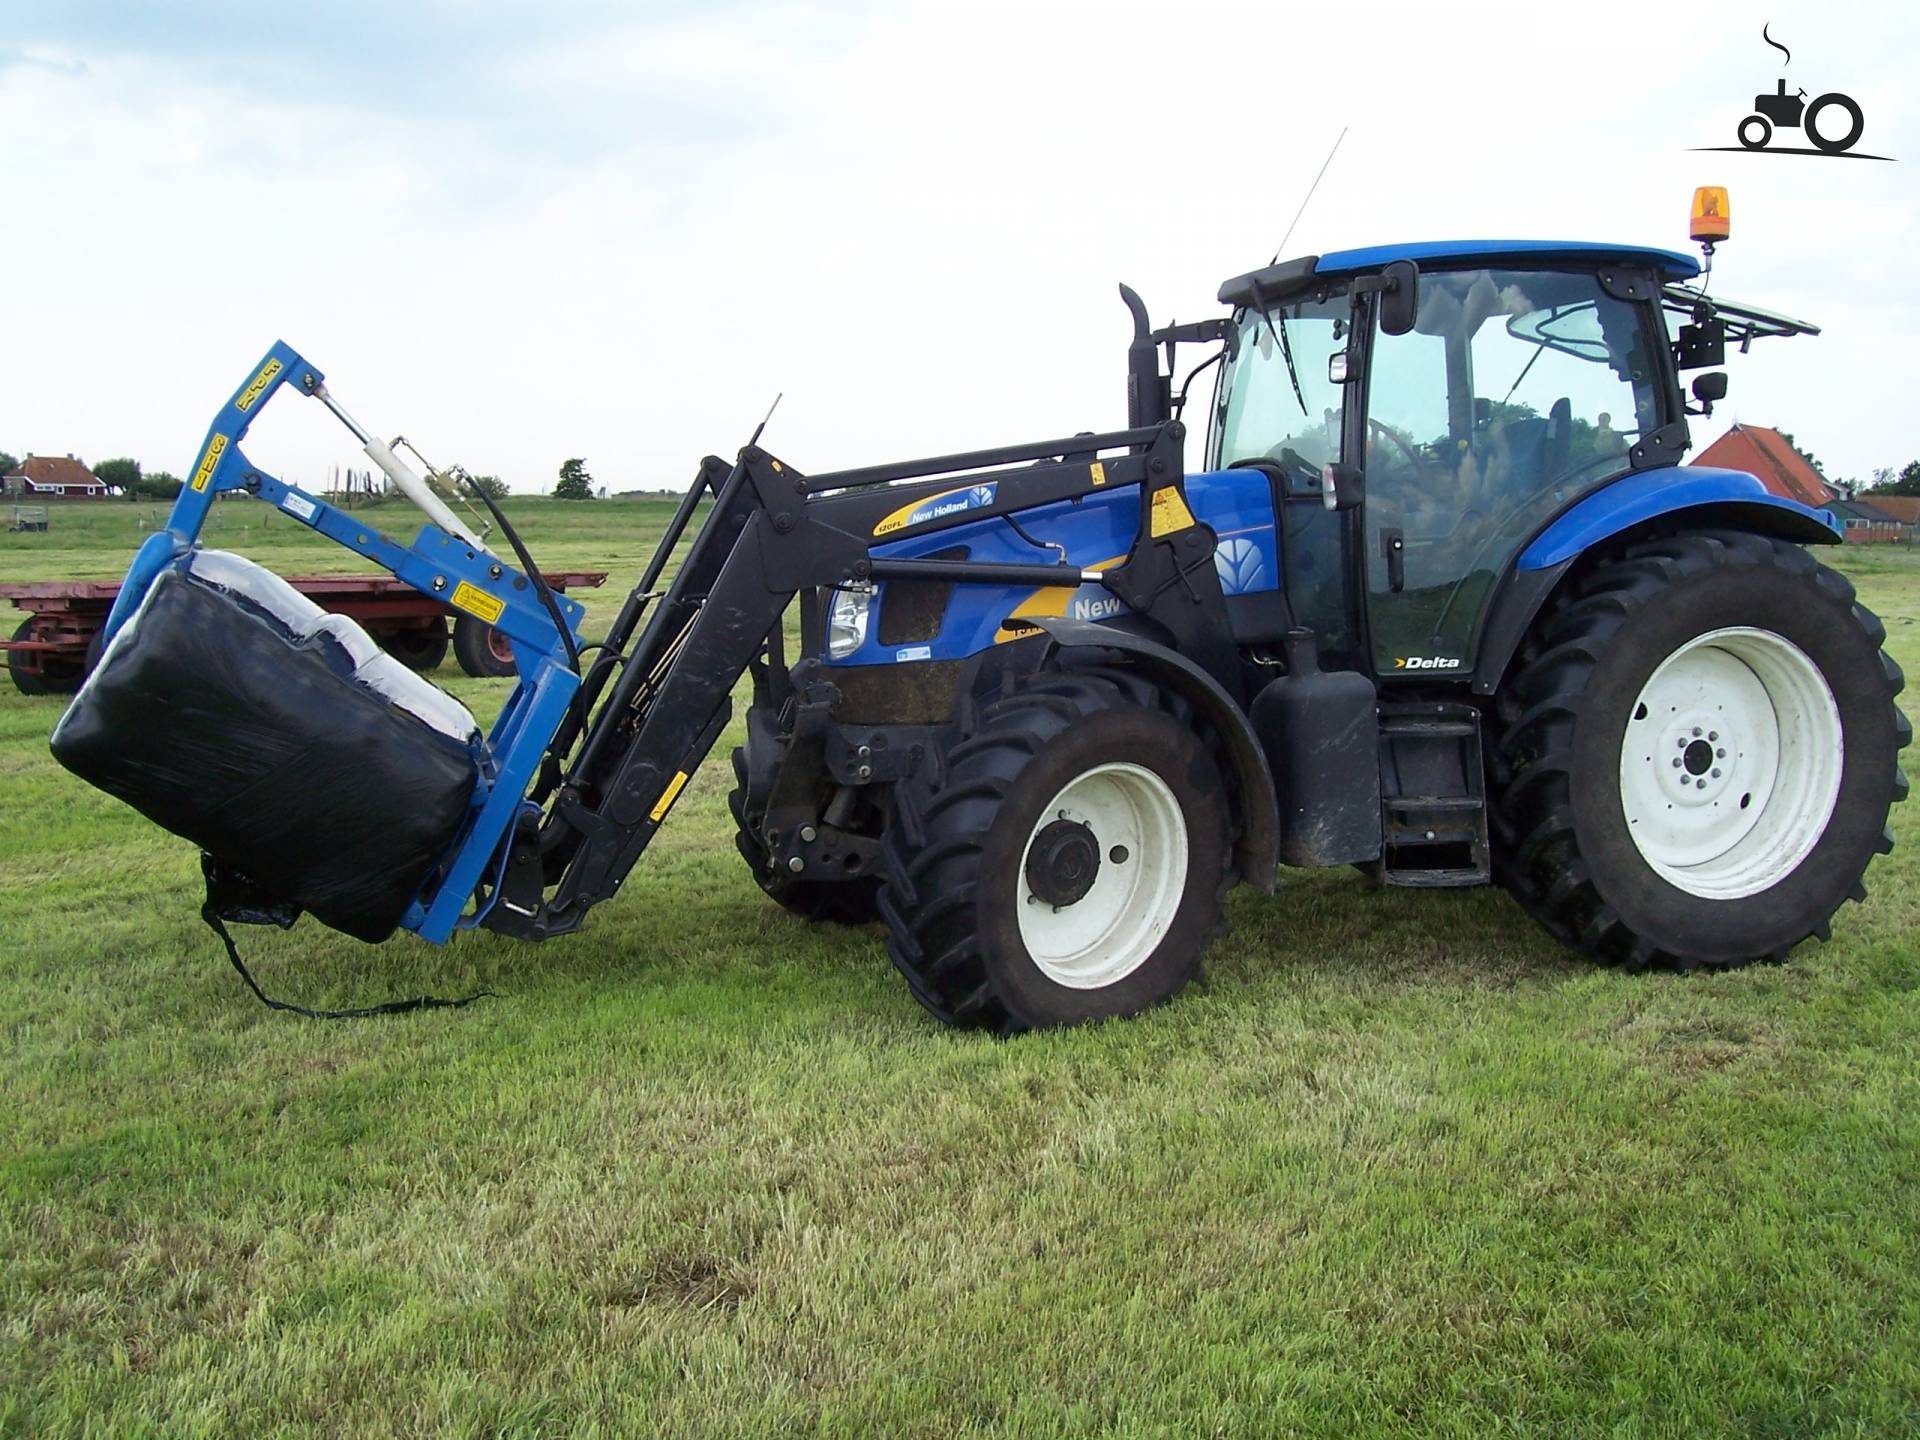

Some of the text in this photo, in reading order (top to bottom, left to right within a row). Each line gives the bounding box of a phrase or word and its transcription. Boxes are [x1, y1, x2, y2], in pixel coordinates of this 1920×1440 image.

[912, 511, 932, 524] New
[934, 499, 968, 517] Holland
[1074, 598, 1121, 620] New
[1405, 656, 1460, 669] Delta
